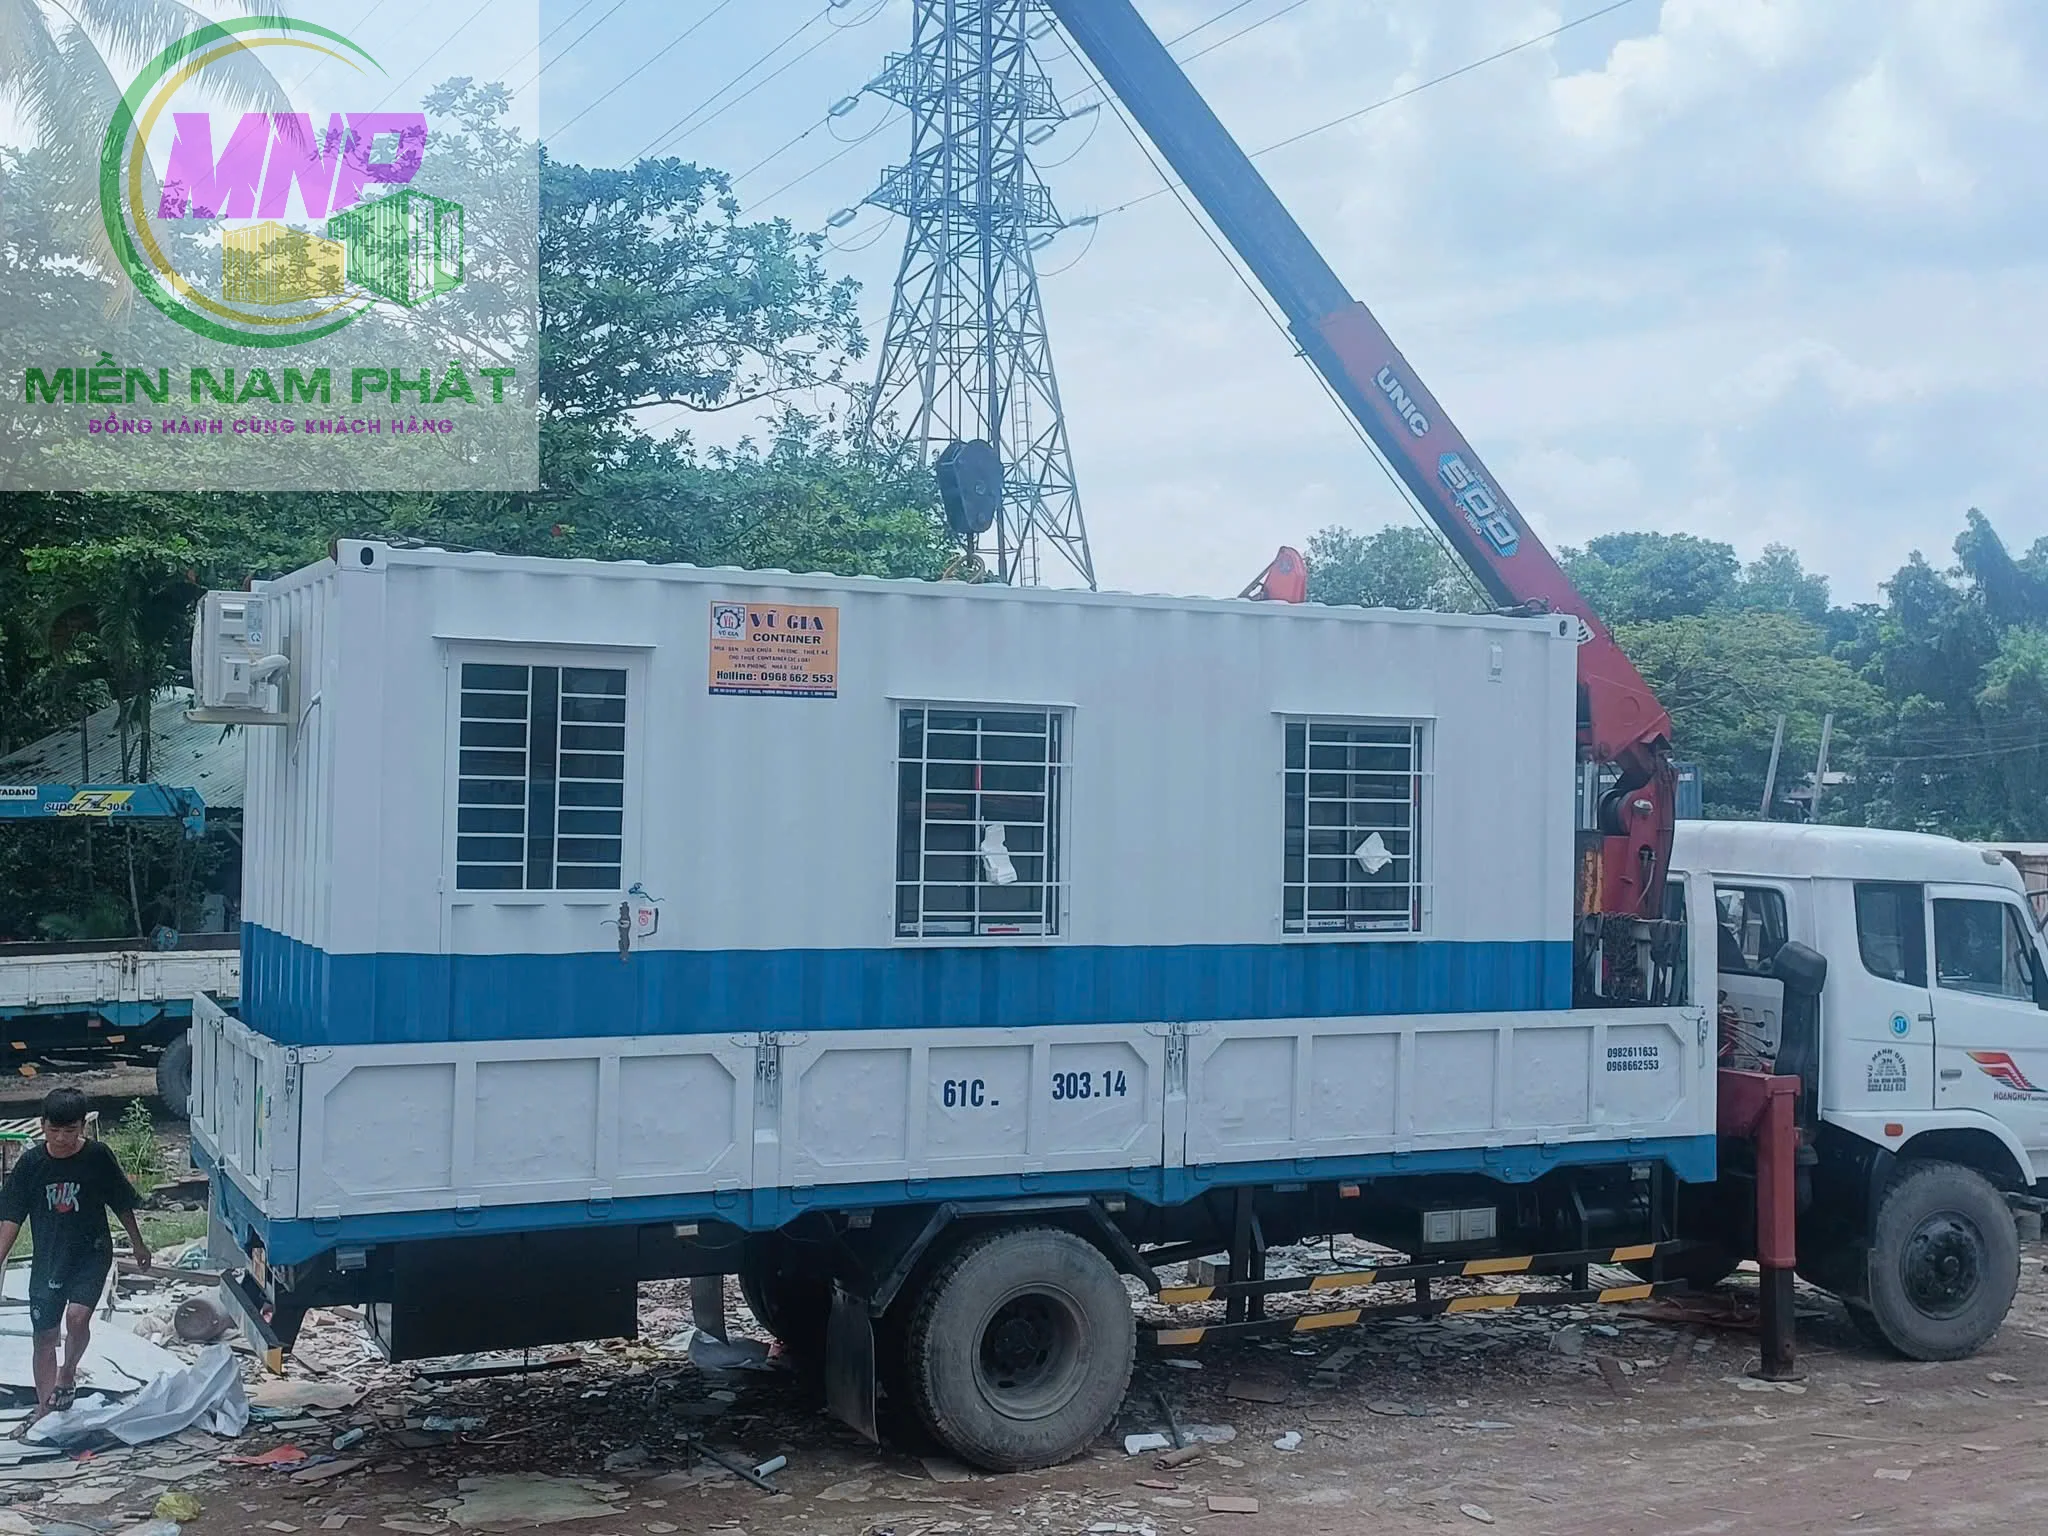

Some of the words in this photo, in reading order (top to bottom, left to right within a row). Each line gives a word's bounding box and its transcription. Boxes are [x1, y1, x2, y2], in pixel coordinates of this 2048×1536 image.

[1377, 367, 1431, 438] UNIC
[750, 609, 780, 628] VŨ
[787, 614, 824, 631] GIA
[752, 633, 822, 645] CONTAINER
[760, 671, 787, 682] 0968
[789, 673, 809, 683] 662
[812, 674, 834, 683] 553
[1607, 1046, 1659, 1058] 0982611633
[1606, 1059, 1659, 1072] 0968662553
[1052, 1070, 1127, 1100] 303.14
